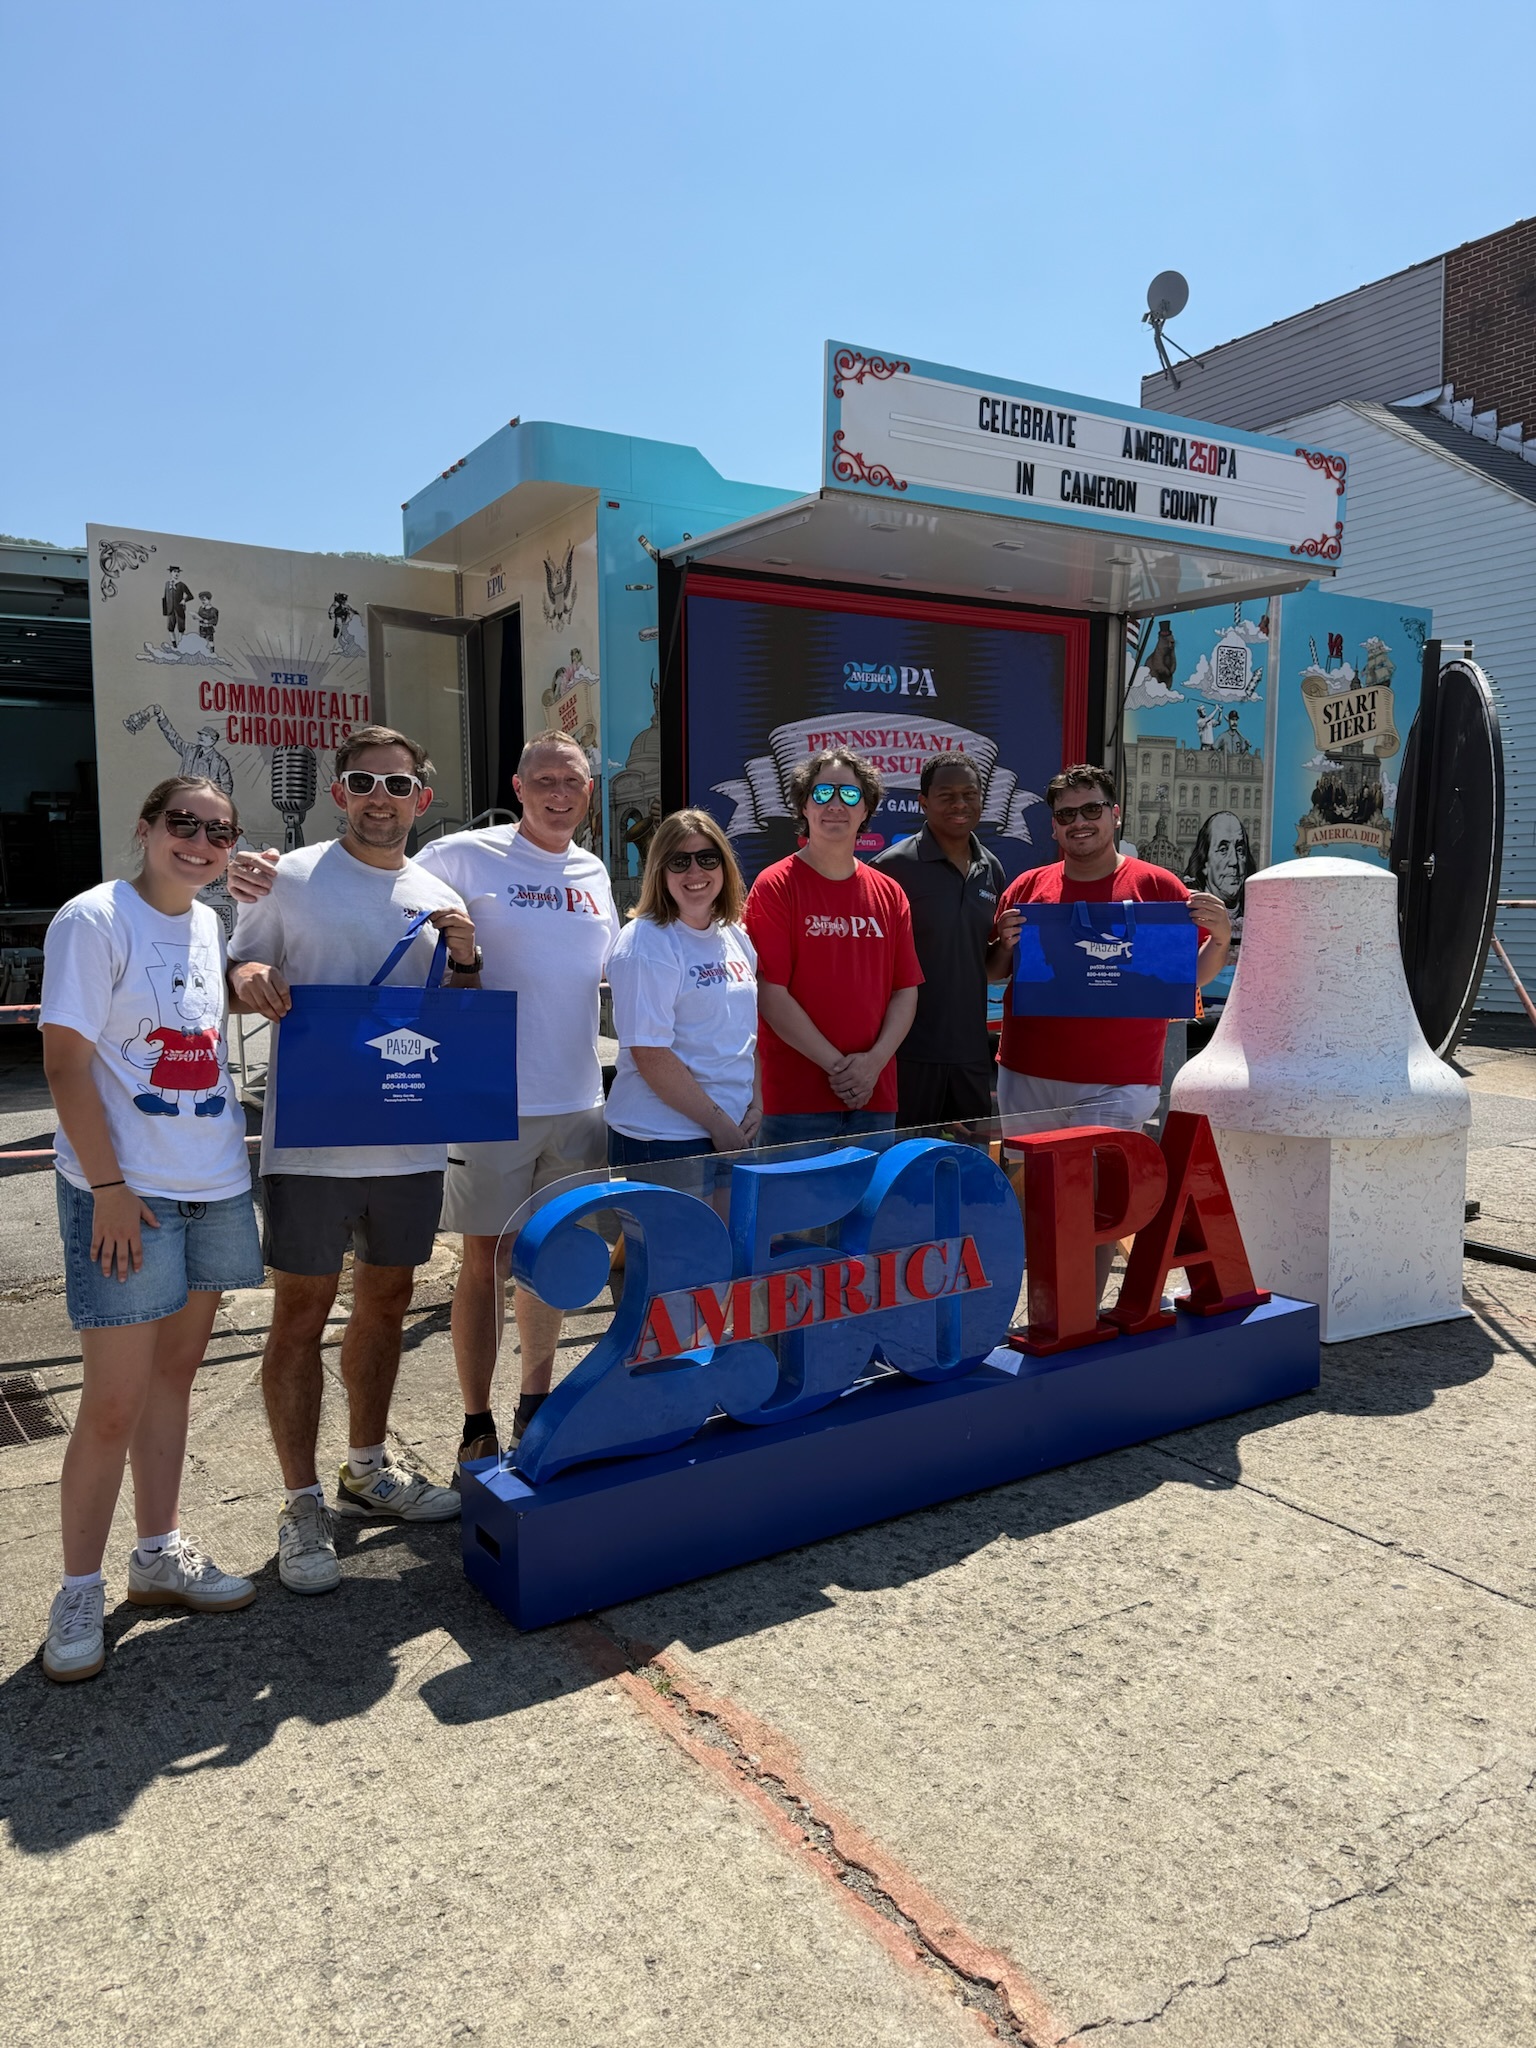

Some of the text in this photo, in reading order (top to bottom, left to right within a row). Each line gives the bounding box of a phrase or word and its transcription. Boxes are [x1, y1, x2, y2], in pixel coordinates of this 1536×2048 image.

[979, 397, 1237, 479] CELEBRATE AMERICA250PA
[1016, 461, 1218, 526] IN CAMERON COUNTY
[486, 572, 507, 599] EPIC
[271, 672, 308, 686] THE
[843, 661, 938, 697] 250 PA
[850, 671, 893, 684] AMERICA
[561, 706, 577, 726] YOUR
[1323, 690, 1379, 725] START
[226, 715, 352, 751] CHRONICLES
[1329, 711, 1377, 743] HERE
[865, 756, 929, 774] RSUI
[1312, 828, 1380, 844] AMERICA DID!
[507, 883, 600, 915] 250 PA
[516, 891, 559, 902] AMERICA
[804, 915, 884, 938] 250 PA
[812, 921, 845, 931] AMERICA
[1090, 942, 1118, 953] PA529
[386, 1038, 421, 1055] PA529
[381, 1082, 426, 1090] 800-440-4000
[386, 1072, 421, 1080] pa529.com
[512, 1138, 1024, 1484] 250
[1004, 1110, 1272, 1357] PA
[626, 1235, 993, 1366] AMERICA
